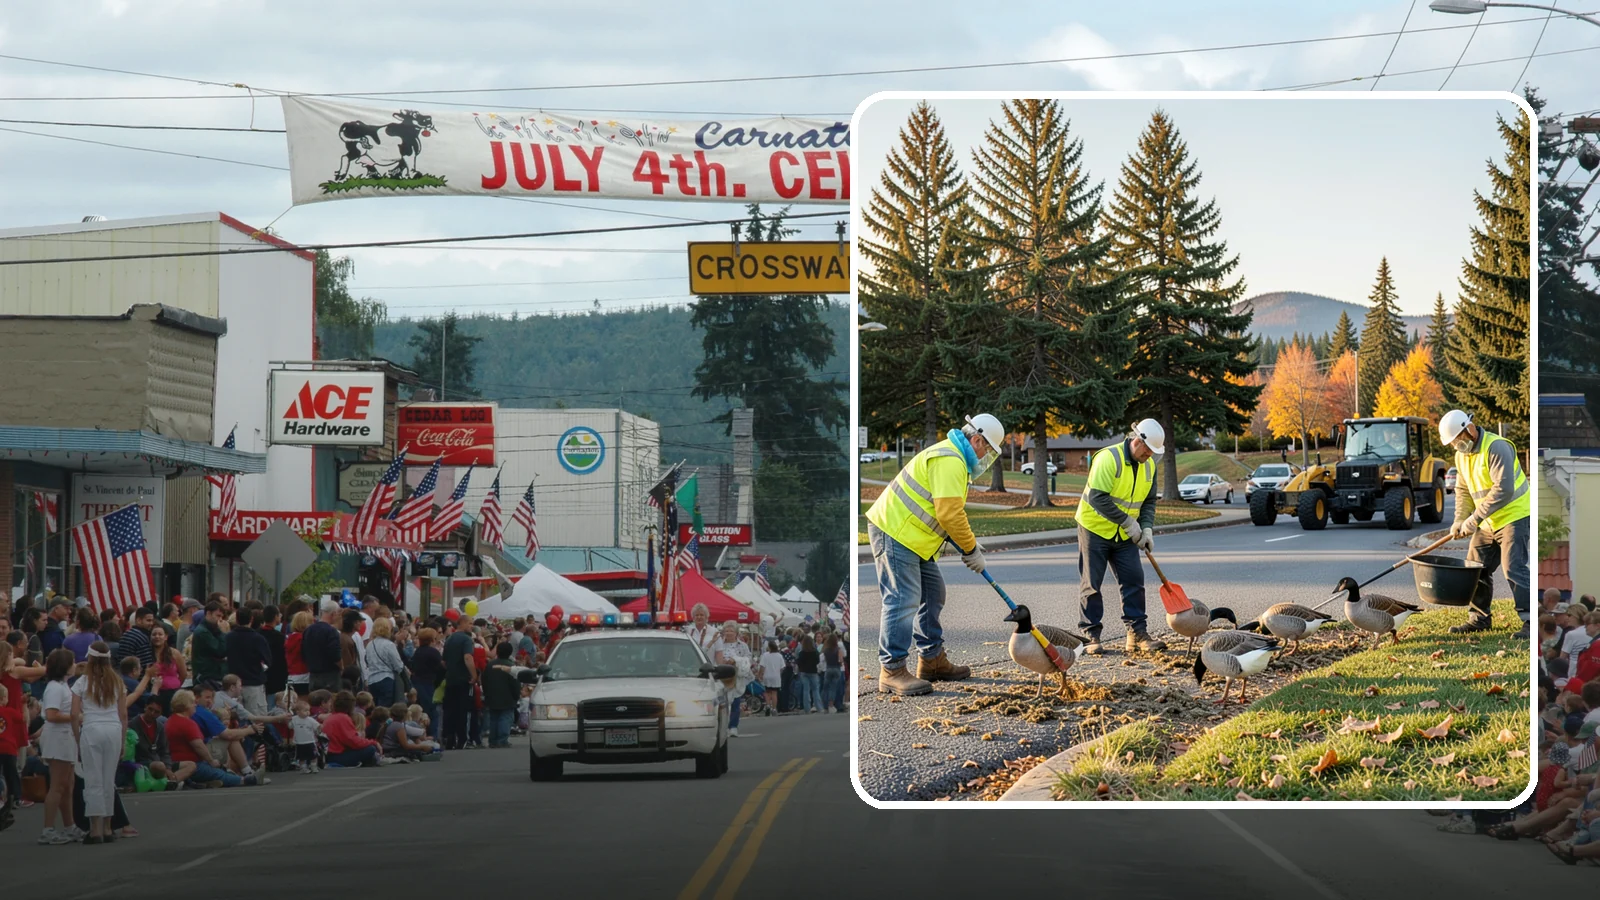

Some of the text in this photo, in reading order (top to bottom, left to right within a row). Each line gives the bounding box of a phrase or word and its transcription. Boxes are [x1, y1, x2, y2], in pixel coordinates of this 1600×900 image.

[481, 140, 605, 193] JULY
[632, 149, 746, 198] 4th.
[697, 253, 850, 280] CROSSWA
[282, 379, 374, 420] ACE
[405, 409, 452, 422] CEDAR
[283, 420, 371, 436] Hardware
[353, 467, 385, 481] Simpl
[83, 484, 155, 495] St. Vincent de Paul
[688, 526, 741, 535] CRNATION
[699, 535, 730, 543] GLASS
